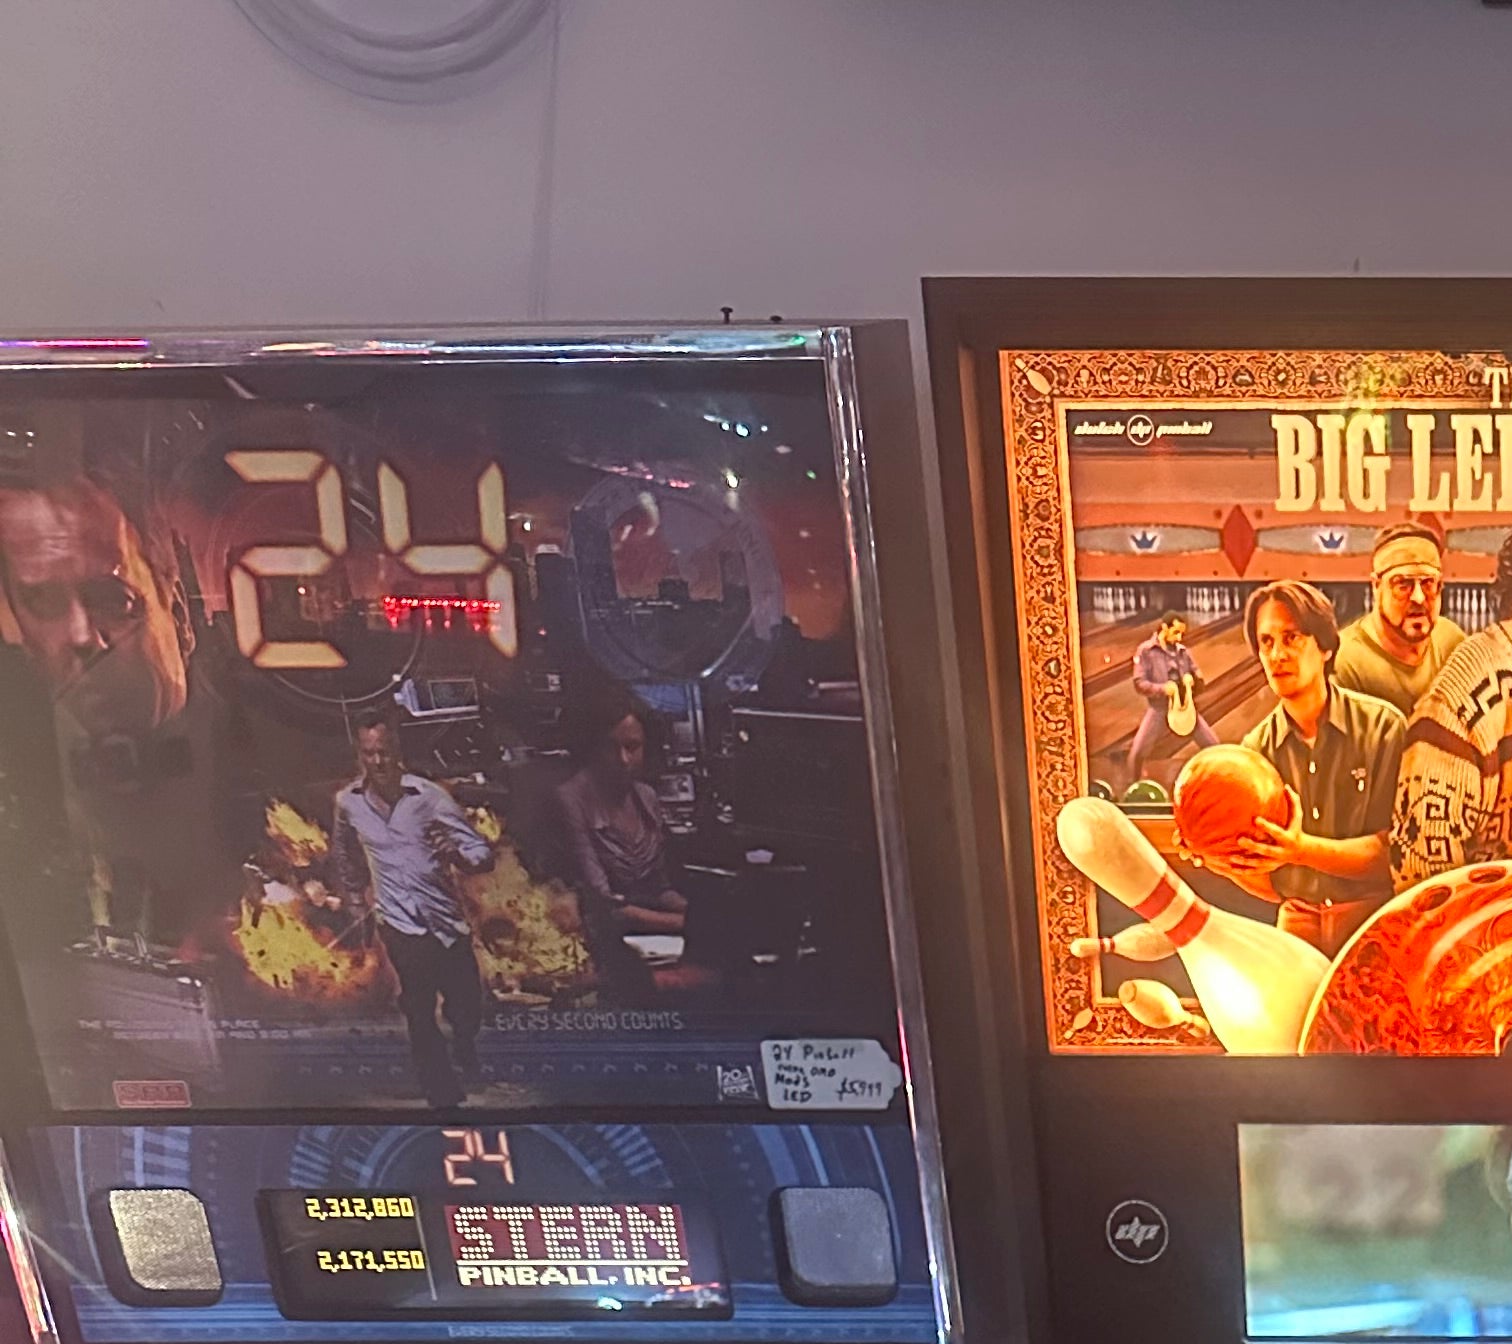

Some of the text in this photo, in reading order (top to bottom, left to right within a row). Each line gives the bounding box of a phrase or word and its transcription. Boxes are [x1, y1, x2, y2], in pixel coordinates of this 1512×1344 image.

[1272, 412, 1392, 512] BIG
[224, 450, 518, 669] 24
[495, 1012, 683, 1031] EVERY SECOND COUNTS
[441, 1129, 515, 1186] 24
[305, 1197, 414, 1221] 2,312,860
[453, 1205, 682, 1260] STERN
[317, 1250, 426, 1273] 2,171,550
[624, 1266, 692, 1286] INC.
